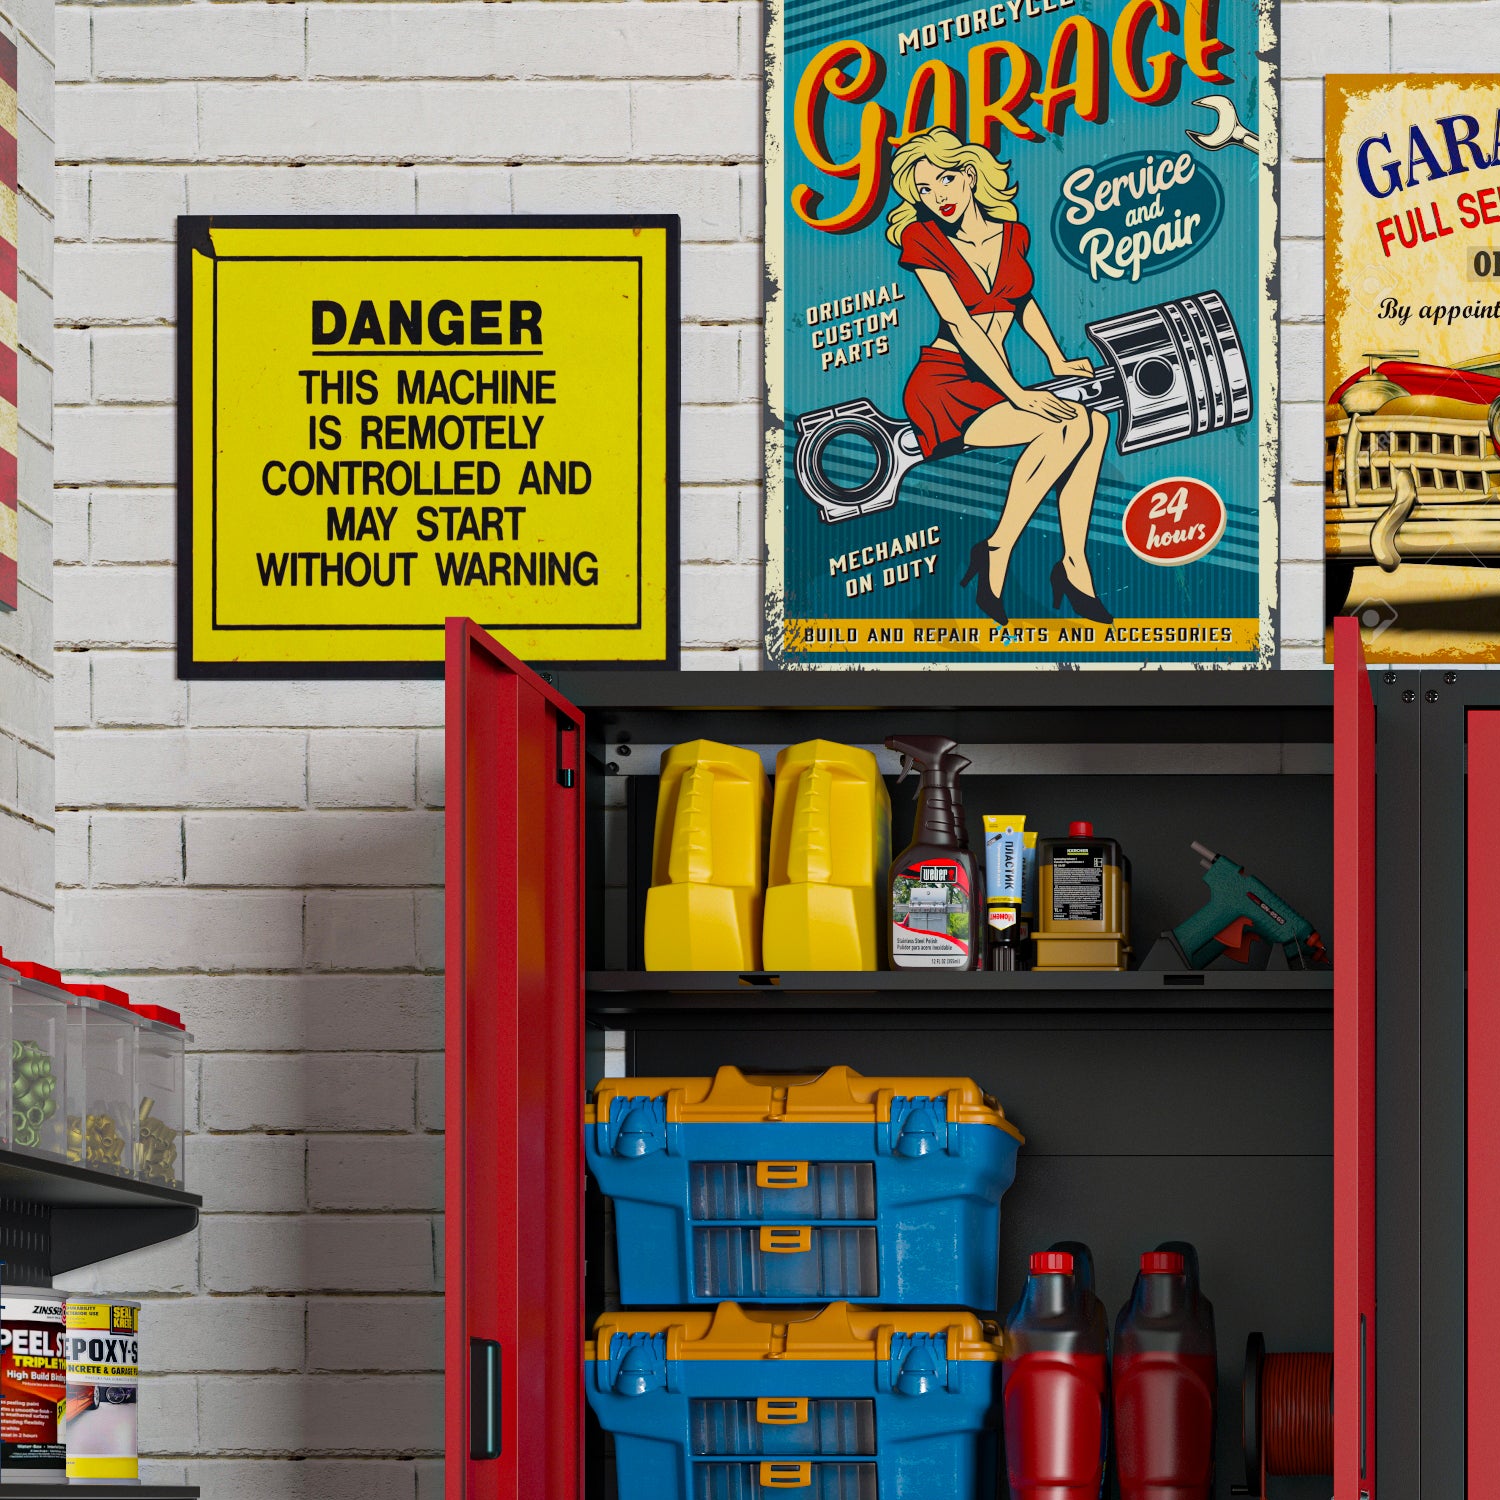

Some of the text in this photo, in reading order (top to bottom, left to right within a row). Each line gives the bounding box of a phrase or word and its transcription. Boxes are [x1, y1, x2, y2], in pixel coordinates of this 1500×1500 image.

[791, 0, 1234, 234] GARAGE
[1063, 152, 1195, 227] Service
[1125, 198, 1164, 227] and
[1376, 202, 1453, 257] FULL
[1080, 213, 1200, 282] Repair
[806, 282, 905, 327] ORIGINAL
[1377, 297, 1412, 324] By
[311, 300, 543, 346] DANGER
[811, 309, 900, 349] CUSTOM
[821, 335, 890, 371] PARTS
[298, 370, 556, 404] THIS MACHINE
[308, 415, 544, 450] IS REMOTELY
[262, 460, 592, 495] CONTROLLED AND
[1148, 486, 1189, 523] 24
[327, 506, 526, 541] MAY START
[1146, 522, 1206, 551] hours
[829, 525, 941, 577] MECHANIC
[257, 552, 599, 586] WITHOUT WARNING
[846, 555, 938, 599] ON DUTY
[804, 626, 1233, 644] BUILD AND REPAIR PARTS AND ACCESSORIES
[923, 867, 948, 881] weber
[1005, 841, 1014, 890] ПЛАСТИК
[0, 1328, 54, 1357] PEEL
[7, 1370, 49, 1380] High Build
[12, 1355, 58, 1369] TRIPLE
[104, 1366, 109, 1374] &
